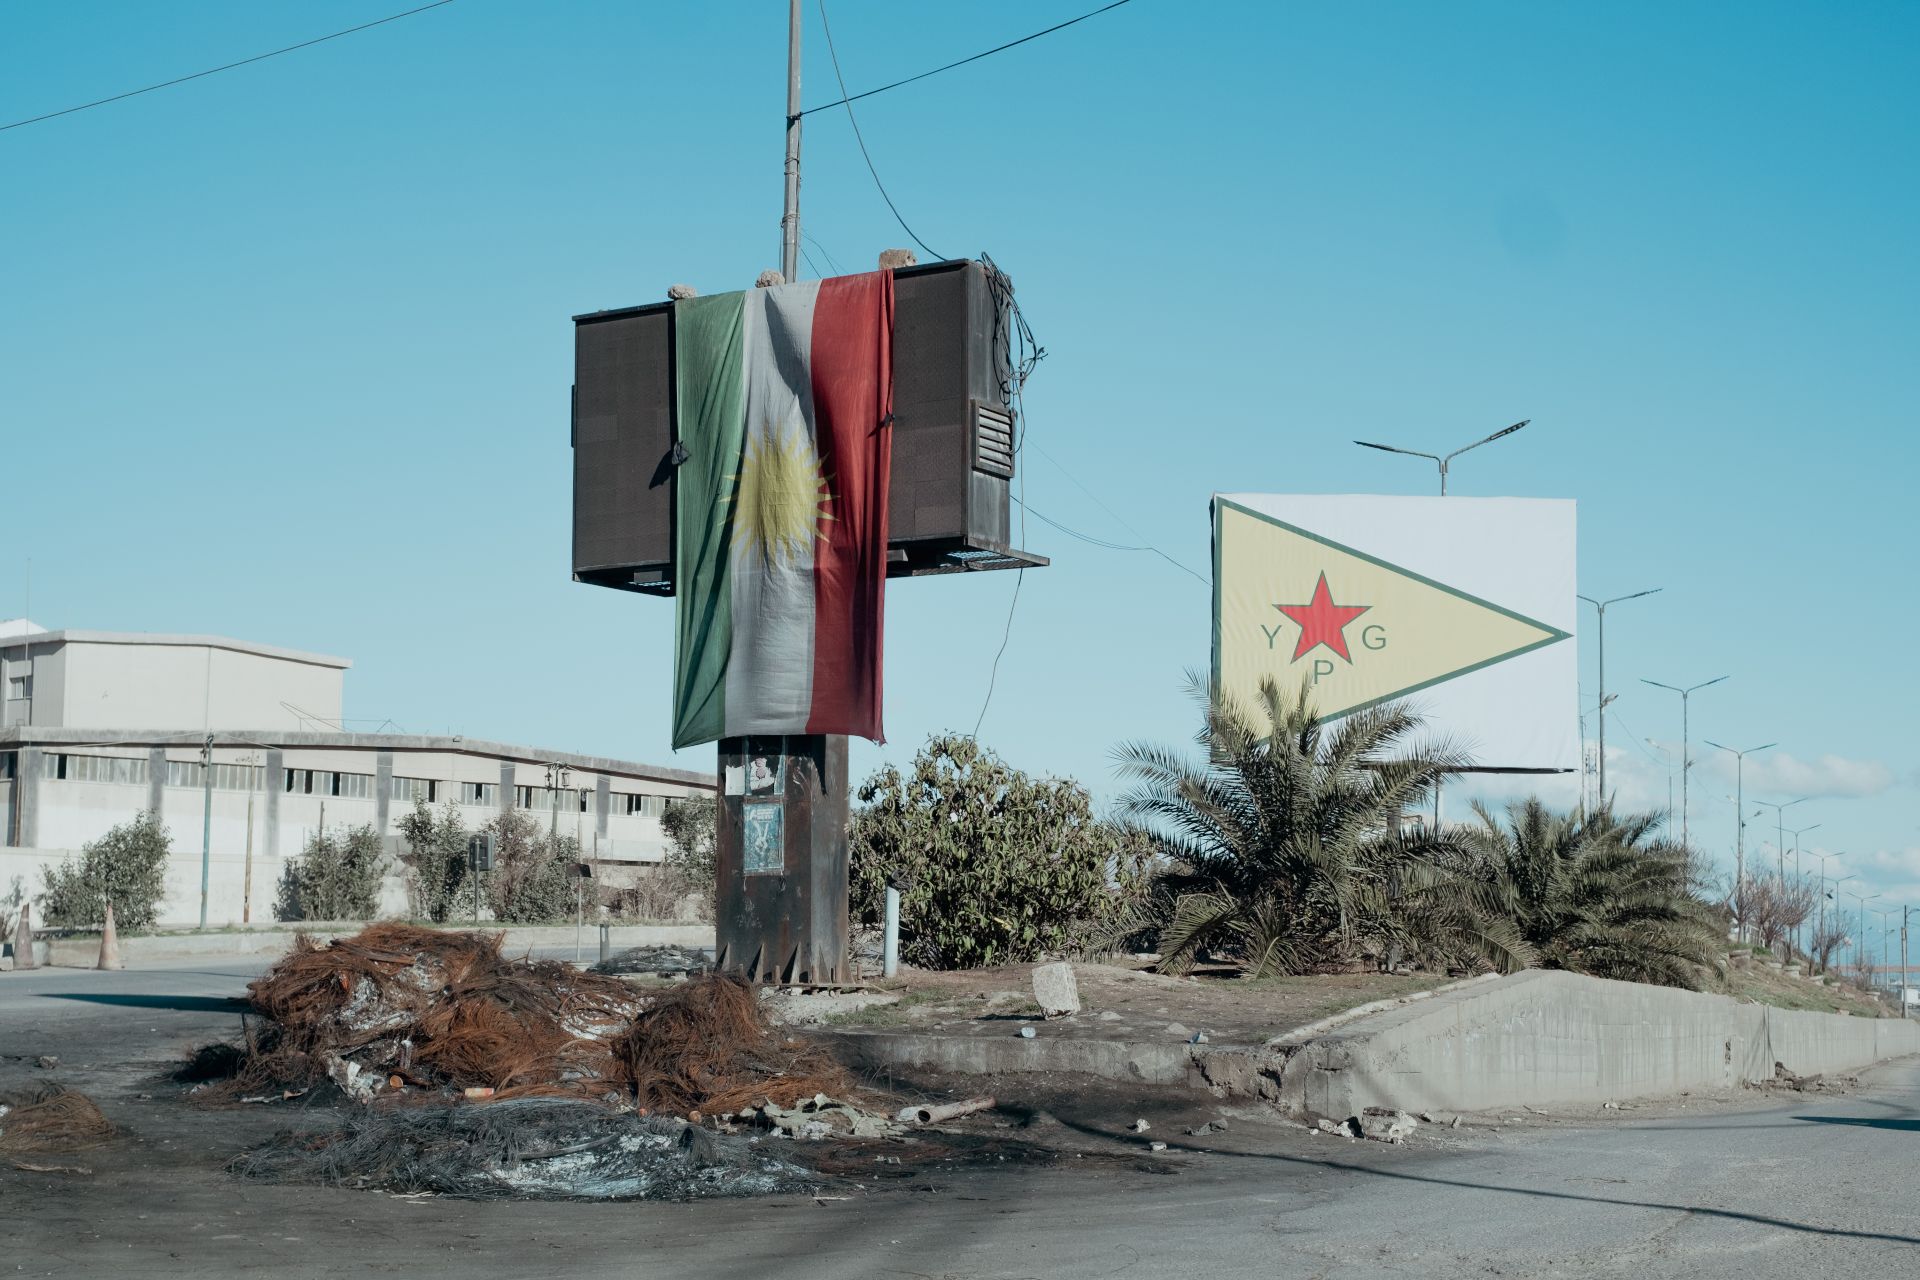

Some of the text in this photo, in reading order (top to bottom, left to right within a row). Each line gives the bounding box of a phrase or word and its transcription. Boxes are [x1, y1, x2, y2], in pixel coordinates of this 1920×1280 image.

[1261, 624, 1387, 684] Y P G
